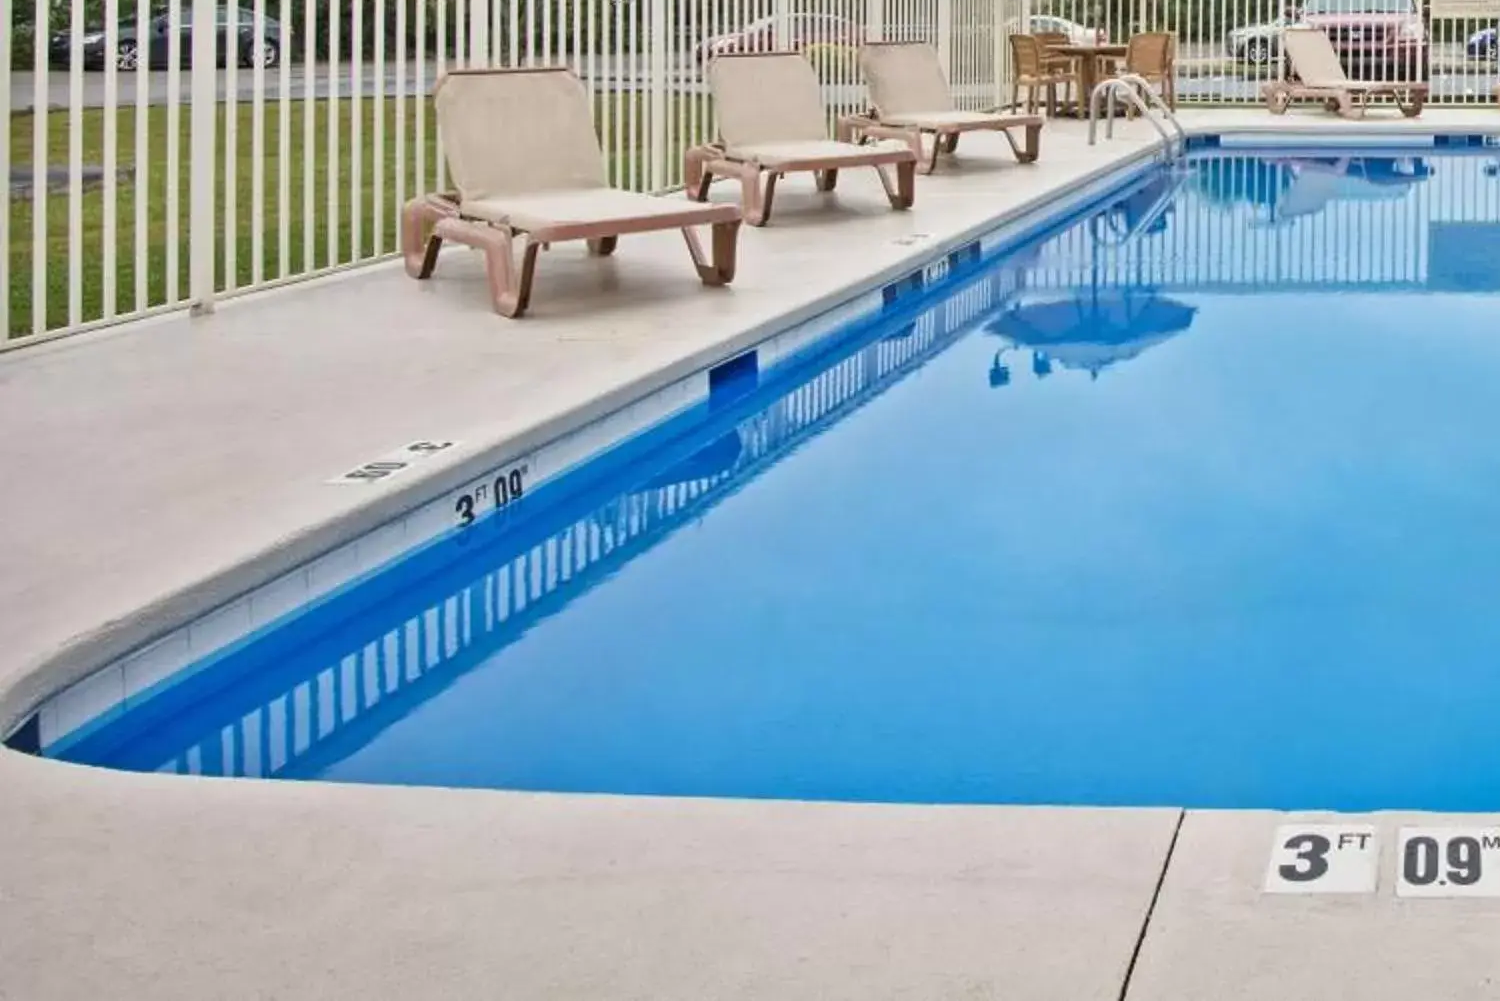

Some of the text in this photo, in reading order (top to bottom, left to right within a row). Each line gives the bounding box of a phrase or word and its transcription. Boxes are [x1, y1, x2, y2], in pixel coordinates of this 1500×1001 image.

[455, 494, 475, 528] 3
[1278, 833, 1331, 882] 3
[1337, 832, 1372, 850] FT
[1403, 836, 1482, 886] 0.9
